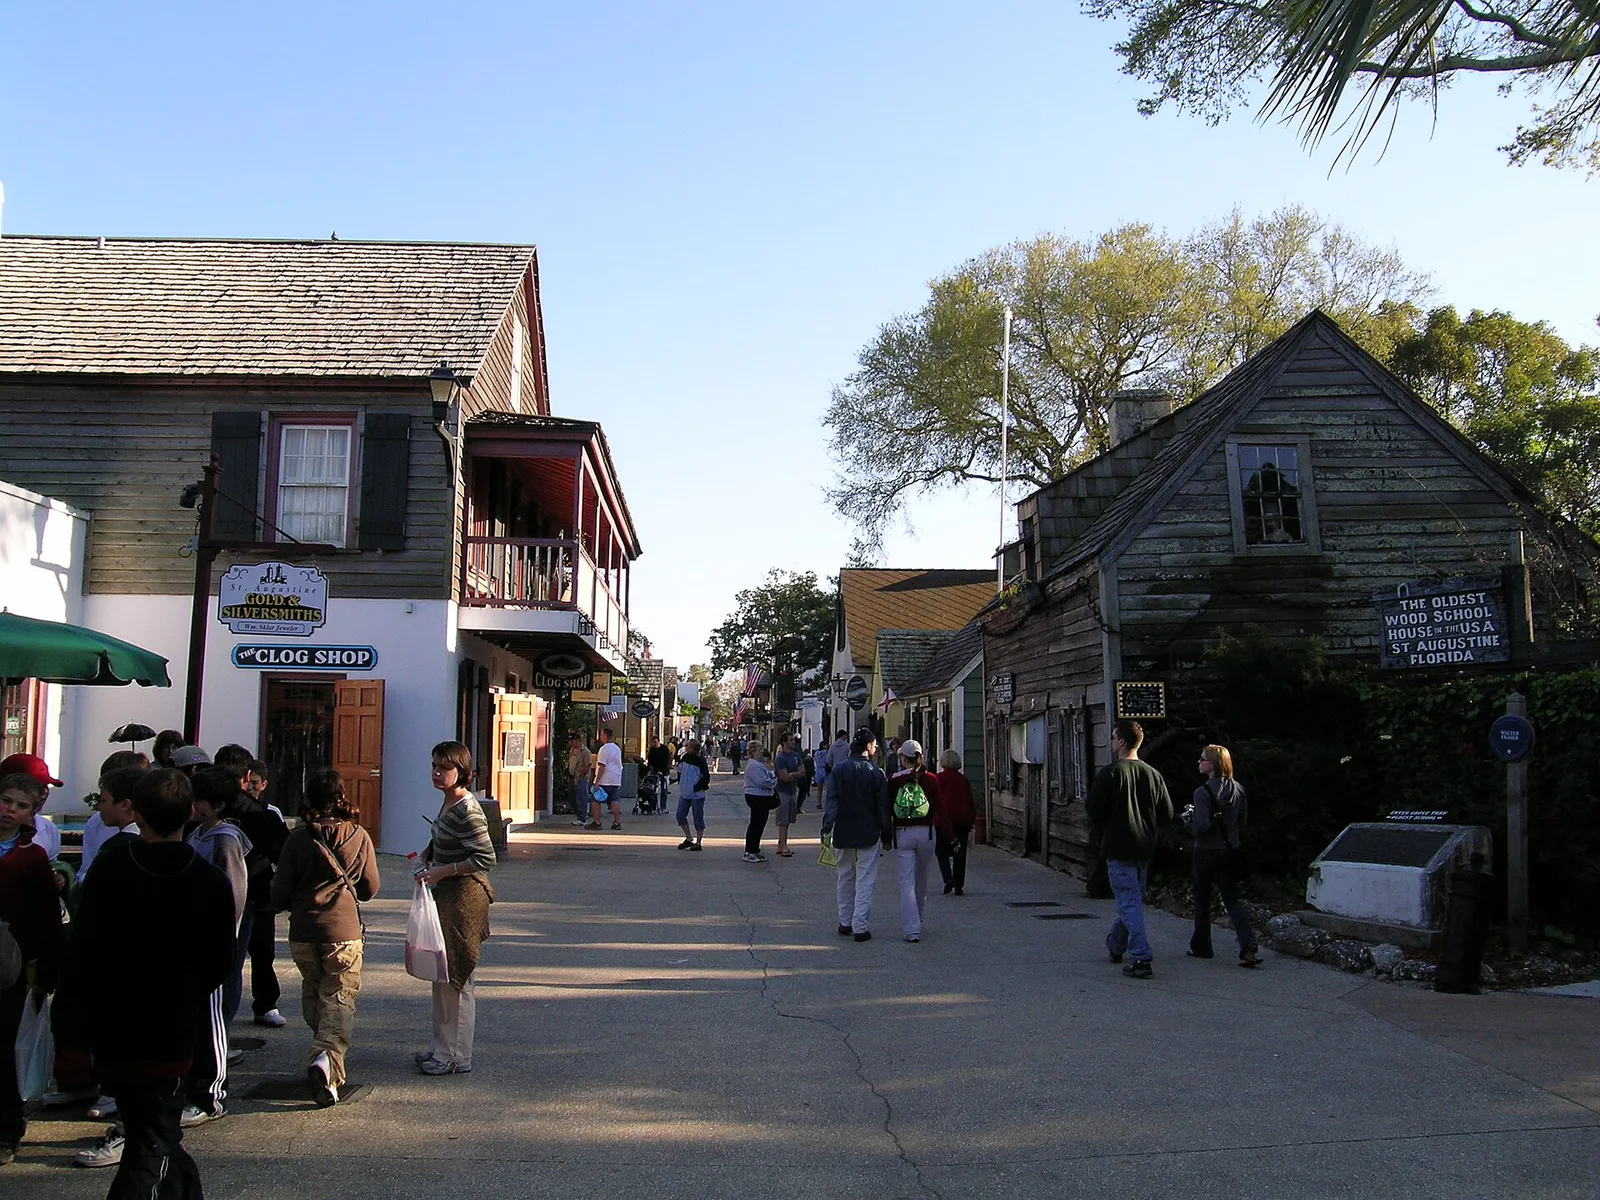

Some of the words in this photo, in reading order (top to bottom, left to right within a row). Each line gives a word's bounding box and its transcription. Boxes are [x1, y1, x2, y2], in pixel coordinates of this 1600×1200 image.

[230, 583, 248, 592] St.
[254, 585, 317, 594] Augustine
[288, 594, 300, 606] &
[1399, 599, 1427, 611] THE
[1432, 592, 1486, 607] OLDEST
[222, 606, 322, 621] SILVERSMITHS
[1385, 612, 1428, 626] WOOD
[1433, 606, 1492, 623] SCHOOL
[1388, 625, 1433, 640] HOUSE
[1445, 625, 1459, 633] THE
[1392, 642, 1410, 654] ST
[1416, 635, 1500, 652] AUGUSTINE
[238, 647, 257, 660] THE
[255, 649, 309, 664] CLOG
[314, 650, 370, 665] SHOP
[1410, 650, 1474, 665] FLORIDA
[535, 672, 561, 687] CLOG
[563, 673, 591, 689] SHOP
